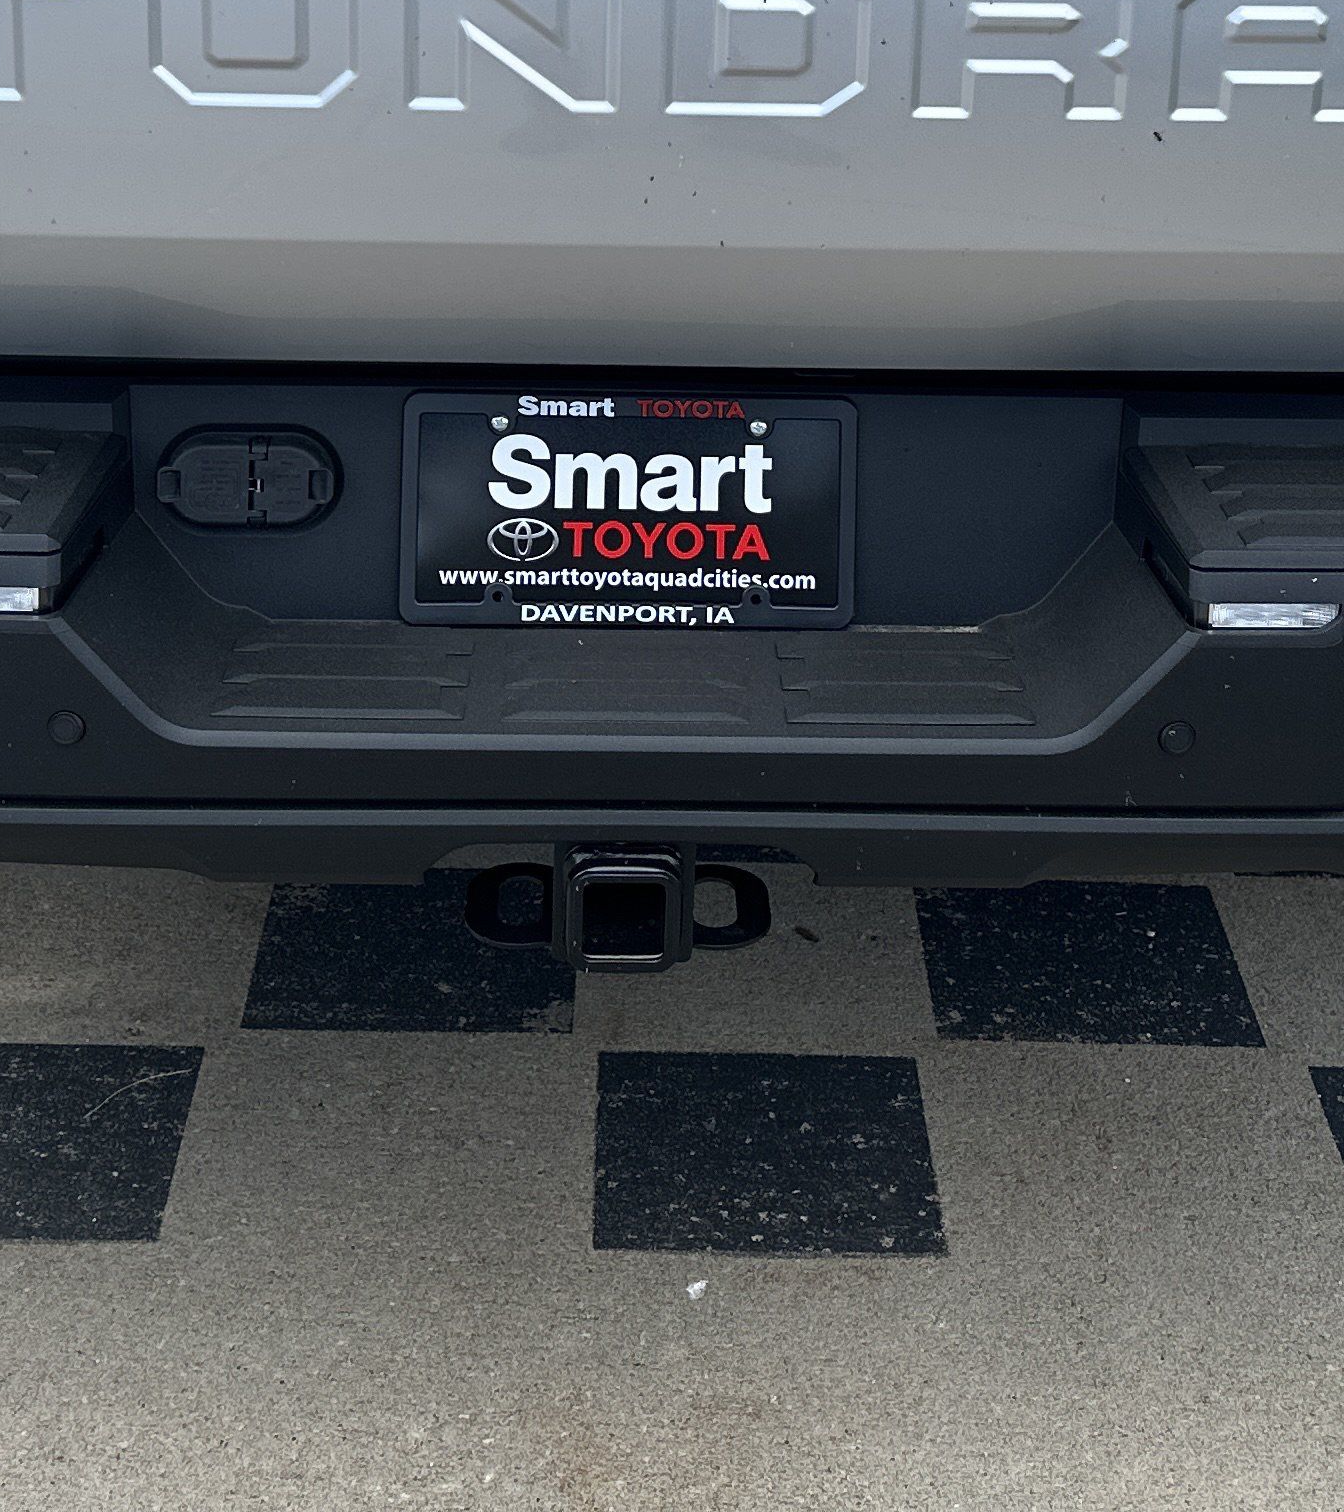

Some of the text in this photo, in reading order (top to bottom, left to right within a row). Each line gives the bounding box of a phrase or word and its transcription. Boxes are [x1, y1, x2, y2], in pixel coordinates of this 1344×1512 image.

[517, 395, 745, 419] Smart TOYOTA
[488, 433, 773, 514] Smart
[564, 520, 771, 561] TOYOTA
[439, 568, 816, 591] www.smarttoyotaquadcities.com
[521, 605, 735, 626] DAVENPORT, IA
